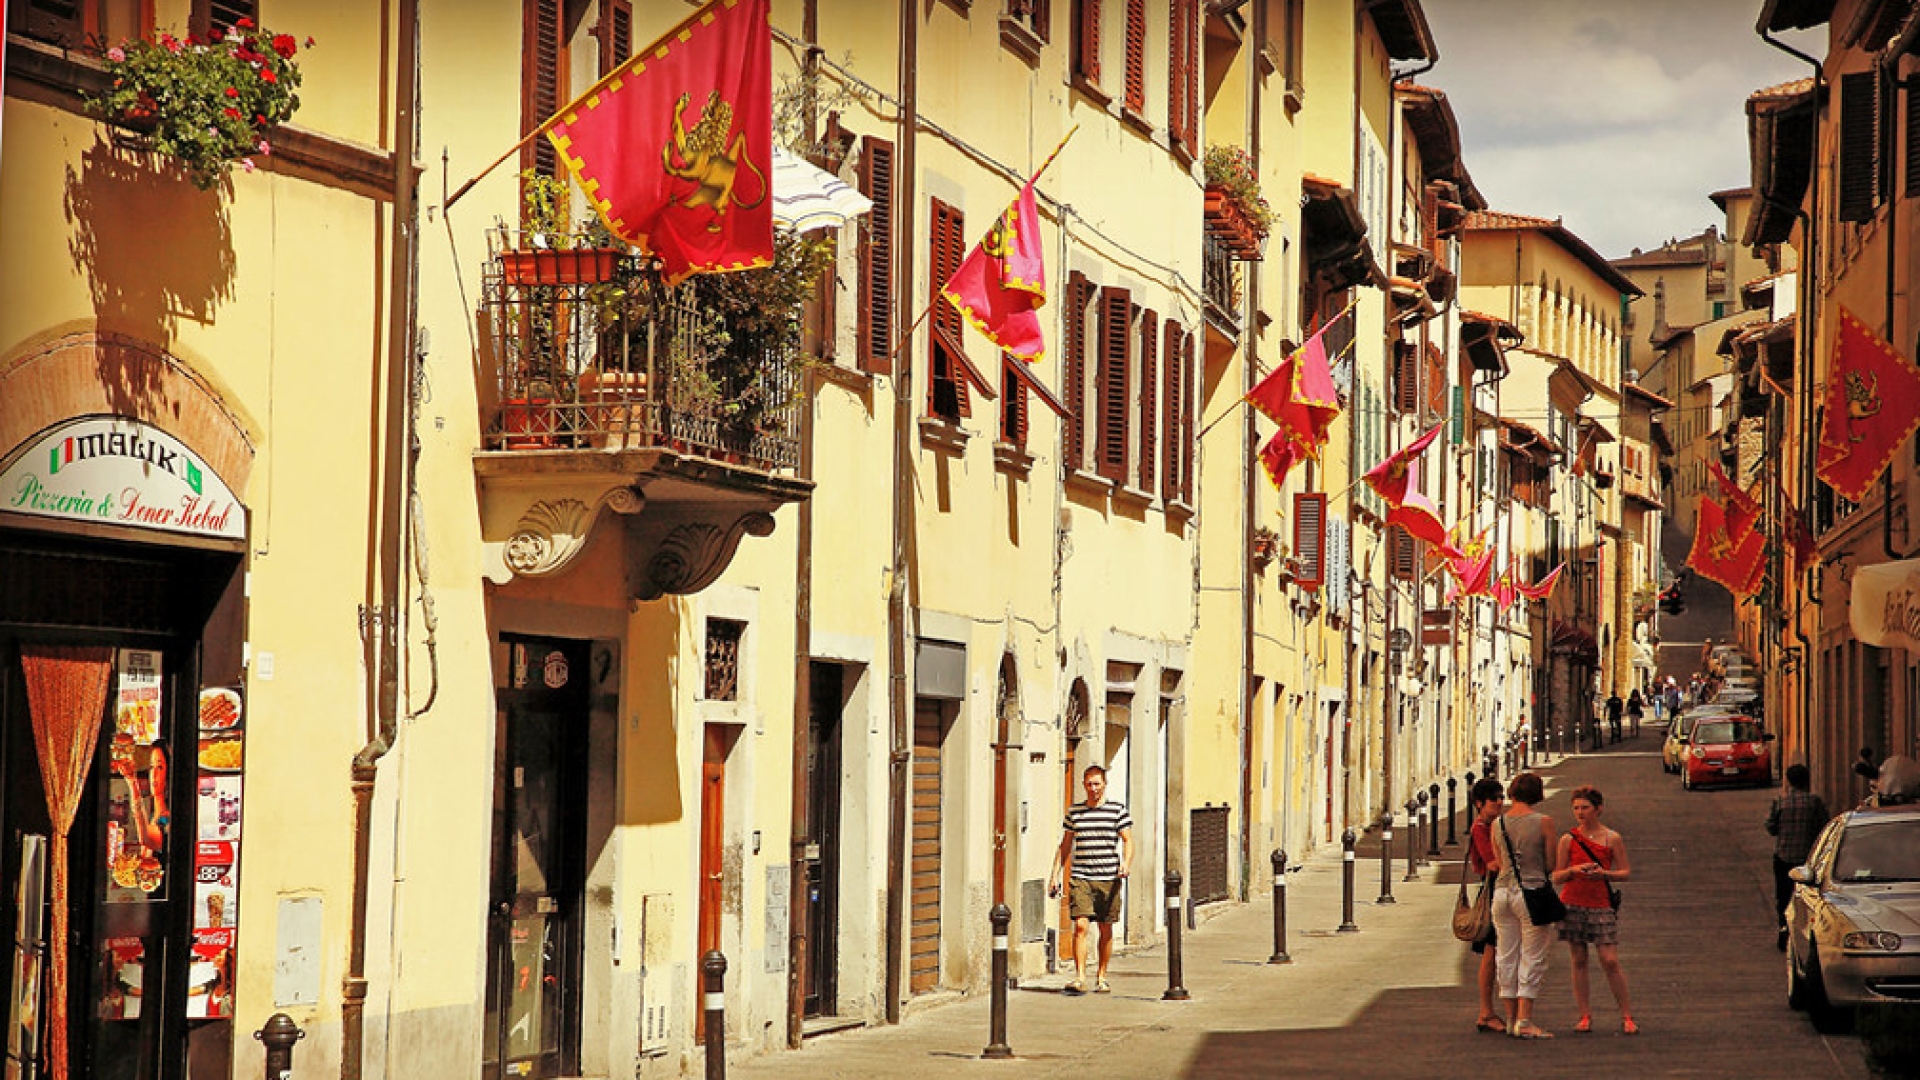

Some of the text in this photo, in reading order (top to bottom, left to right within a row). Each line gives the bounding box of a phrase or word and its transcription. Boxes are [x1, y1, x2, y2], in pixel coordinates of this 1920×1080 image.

[77, 432, 178, 475] MALIK
[10, 472, 94, 515] Pizzeria
[97, 492, 115, 517] &
[174, 494, 234, 532] Kebab
